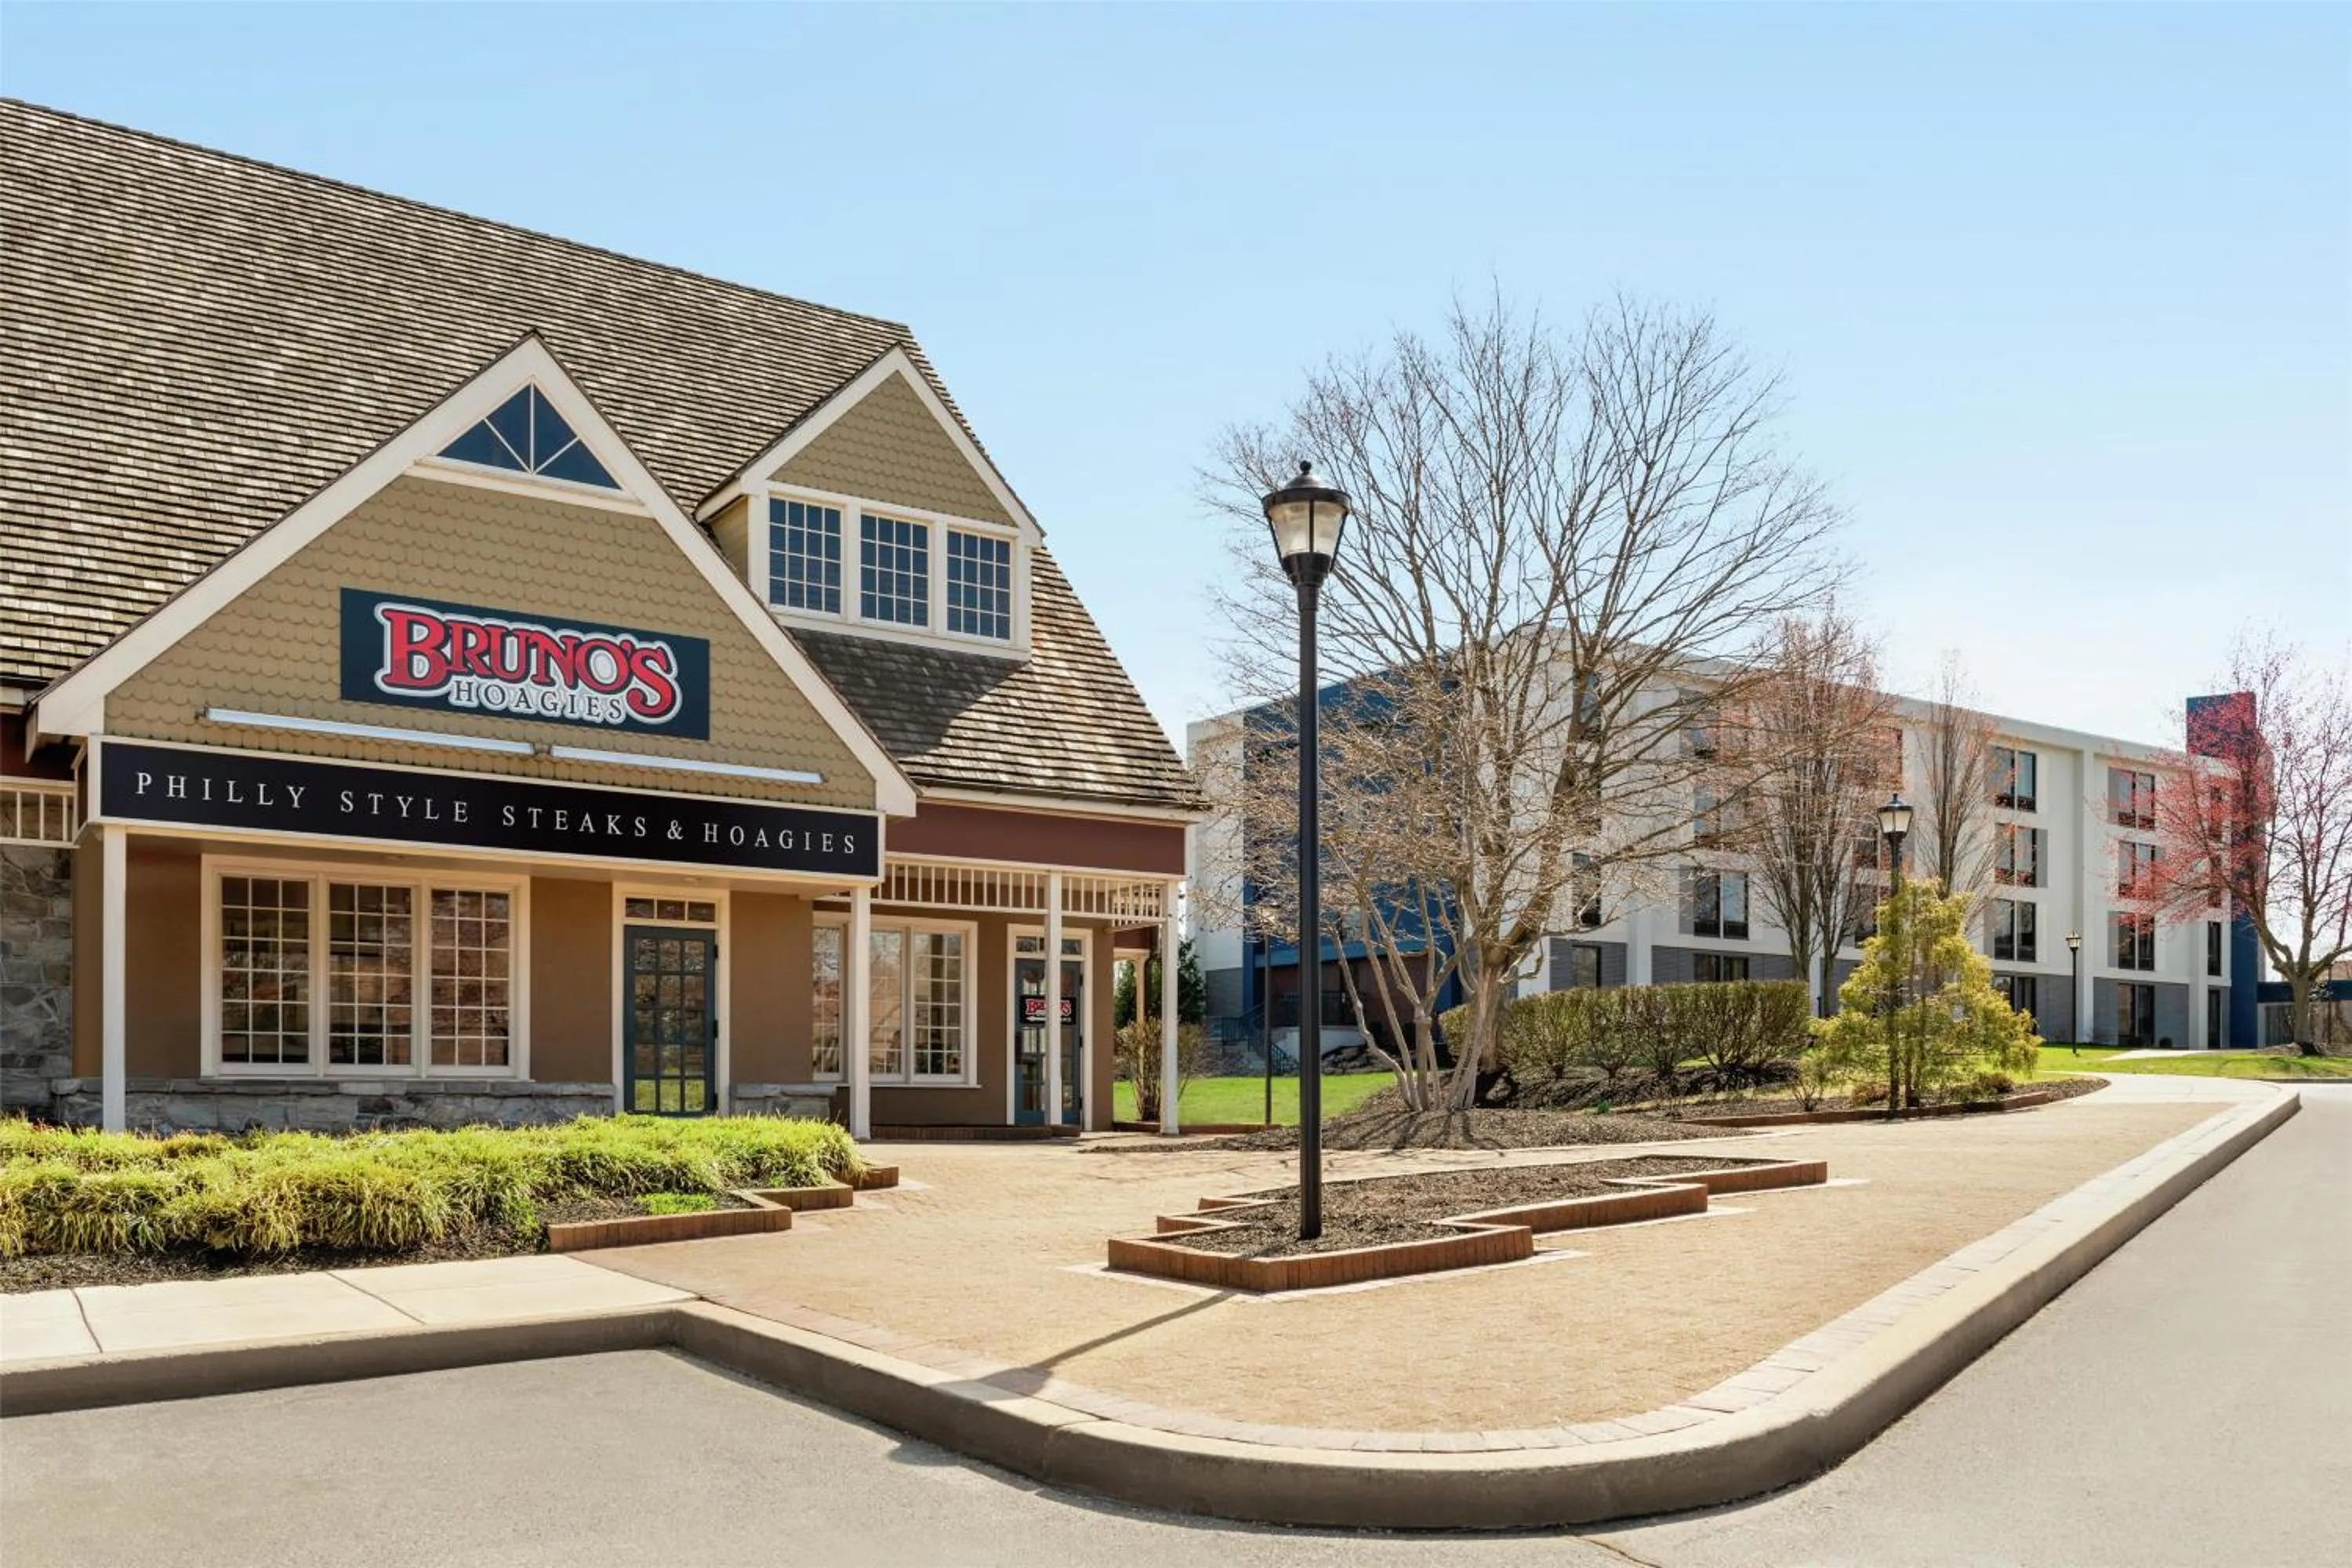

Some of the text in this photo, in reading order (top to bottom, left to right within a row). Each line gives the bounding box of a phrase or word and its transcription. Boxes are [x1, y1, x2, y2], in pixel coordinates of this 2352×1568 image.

[379, 608, 677, 719] BRUNO'S
[452, 680, 624, 720] HOAGIES
[135, 771, 855, 855] PHILLY STYLE STEAKS & HOAGIES
